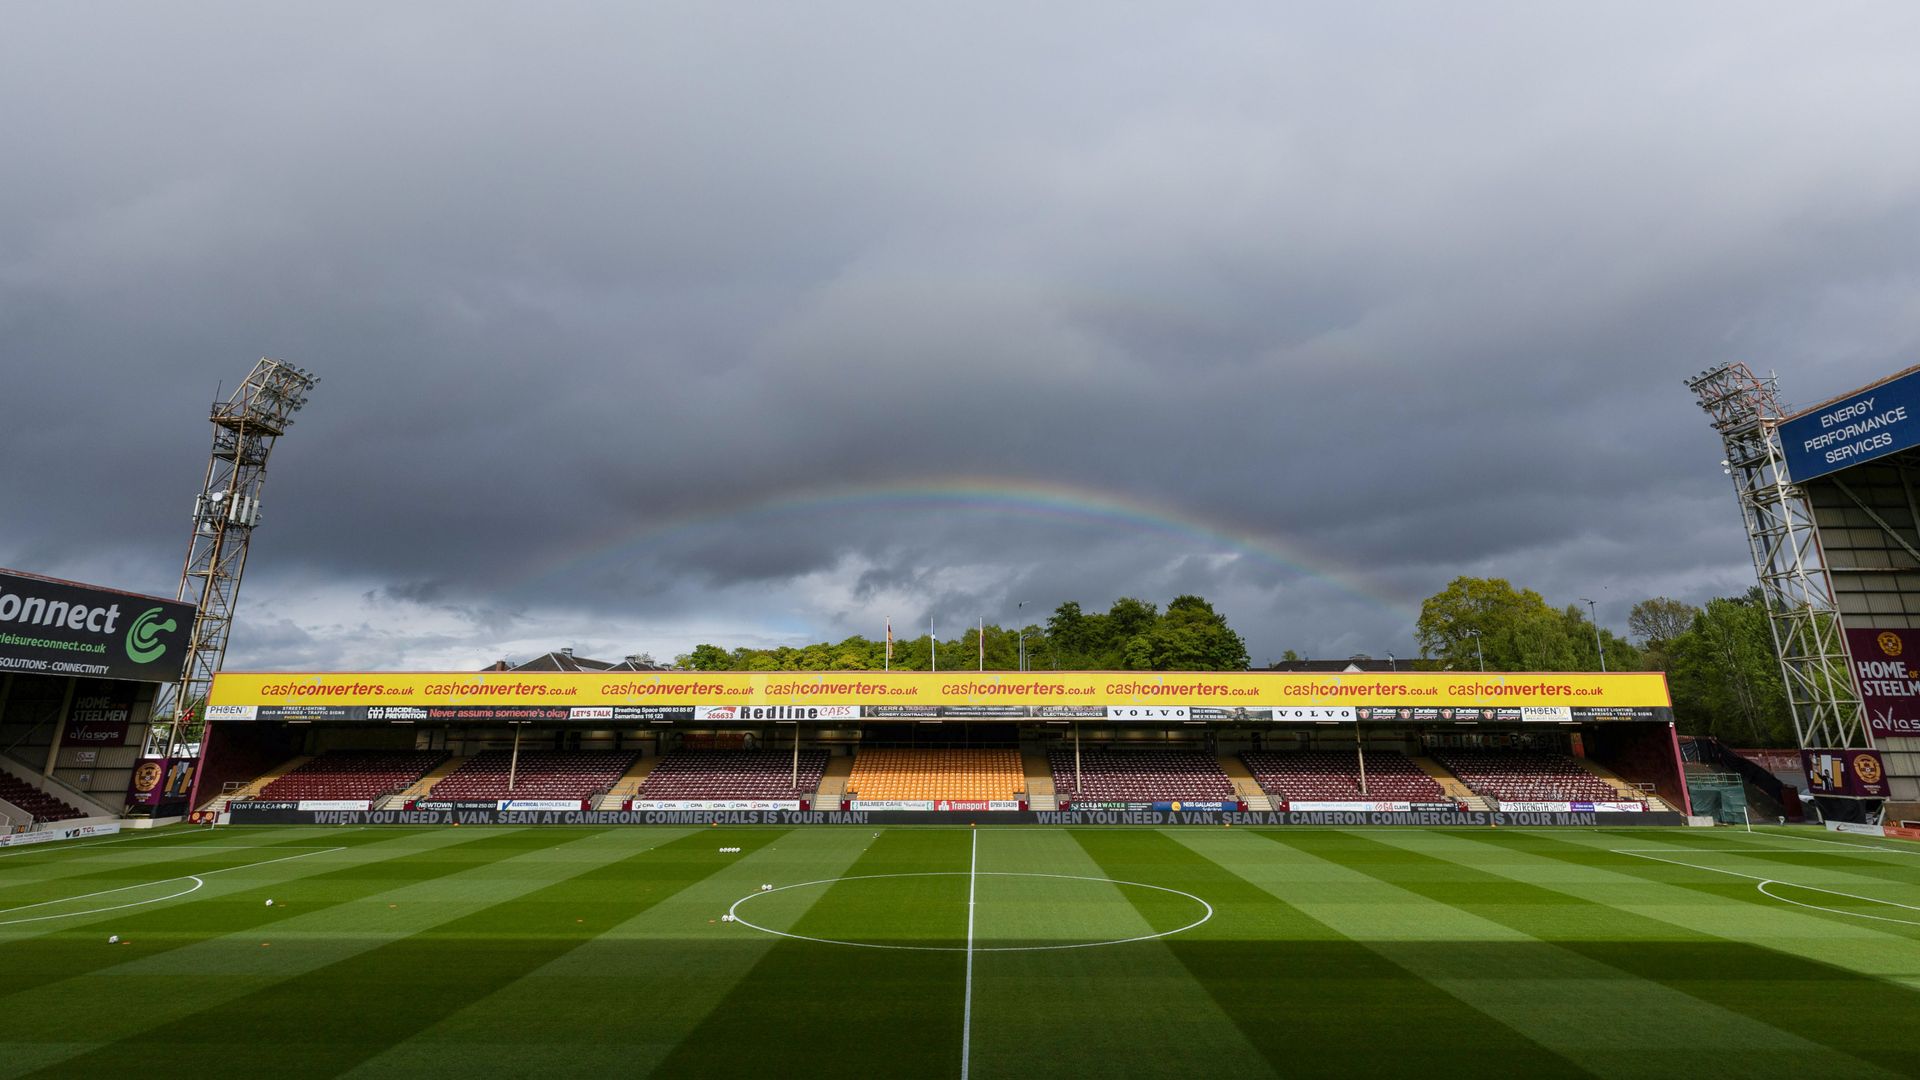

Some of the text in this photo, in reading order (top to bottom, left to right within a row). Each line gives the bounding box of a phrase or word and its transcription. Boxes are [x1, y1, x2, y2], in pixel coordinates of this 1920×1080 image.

[1820, 397, 1875, 428] ENERGY
[1804, 406, 1908, 453] PERFORMANCE
[1826, 432, 1892, 464] SERVICES
[0, 586, 121, 634] onnect
[0, 632, 106, 654] leisureconnect.co.uk
[52, 661, 110, 674] CONNECTIVITY
[1857, 661, 1908, 678] HOME
[261, 682, 414, 696] cashconverters.co.uk
[424, 682, 578, 696] cashconverters.co.uk
[601, 682, 754, 696] cashconverters.co.uk
[764, 682, 918, 696] cashconverters.co.uk
[942, 682, 1096, 696] cashconverters.co.uk
[1106, 682, 1260, 696] cashconverters.co.uk
[1284, 682, 1438, 696] cashconverters.co.uk
[1448, 682, 1603, 696] cashconverters.co.uk
[76, 696, 110, 709] HOME
[72, 710, 128, 722] STEELMEN
[430, 709, 456, 717] Never
[496, 708, 544, 717] someone's
[547, 709, 568, 719] okay
[740, 706, 850, 719] Redline CABS
[1113, 709, 1184, 717] VOLVO
[951, 801, 986, 810] Transport
[314, 811, 359, 824] WHEN
[364, 811, 394, 824] YOU
[399, 811, 439, 824] NEED
[443, 811, 452, 824] A
[498, 811, 539, 824] SEAN
[542, 811, 562, 824] AT
[565, 811, 641, 824] CAMERON
[645, 811, 758, 824] COMMERCIALS
[763, 811, 777, 824] IS
[782, 811, 823, 824] YOUR
[828, 811, 868, 824] MAN!
[1036, 812, 1082, 825] WHEN
[1085, 812, 1118, 825] YOU
[1122, 812, 1163, 825] NEED
[1168, 812, 1178, 825] A
[1222, 812, 1263, 825] SEAN
[1268, 812, 1286, 825] AT
[1290, 812, 1366, 825] CAMERON
[1371, 812, 1486, 825] COMMERCIALS
[1491, 812, 1505, 825] IS
[1510, 812, 1551, 825] YOUR
[1556, 812, 1596, 825] MAN!
